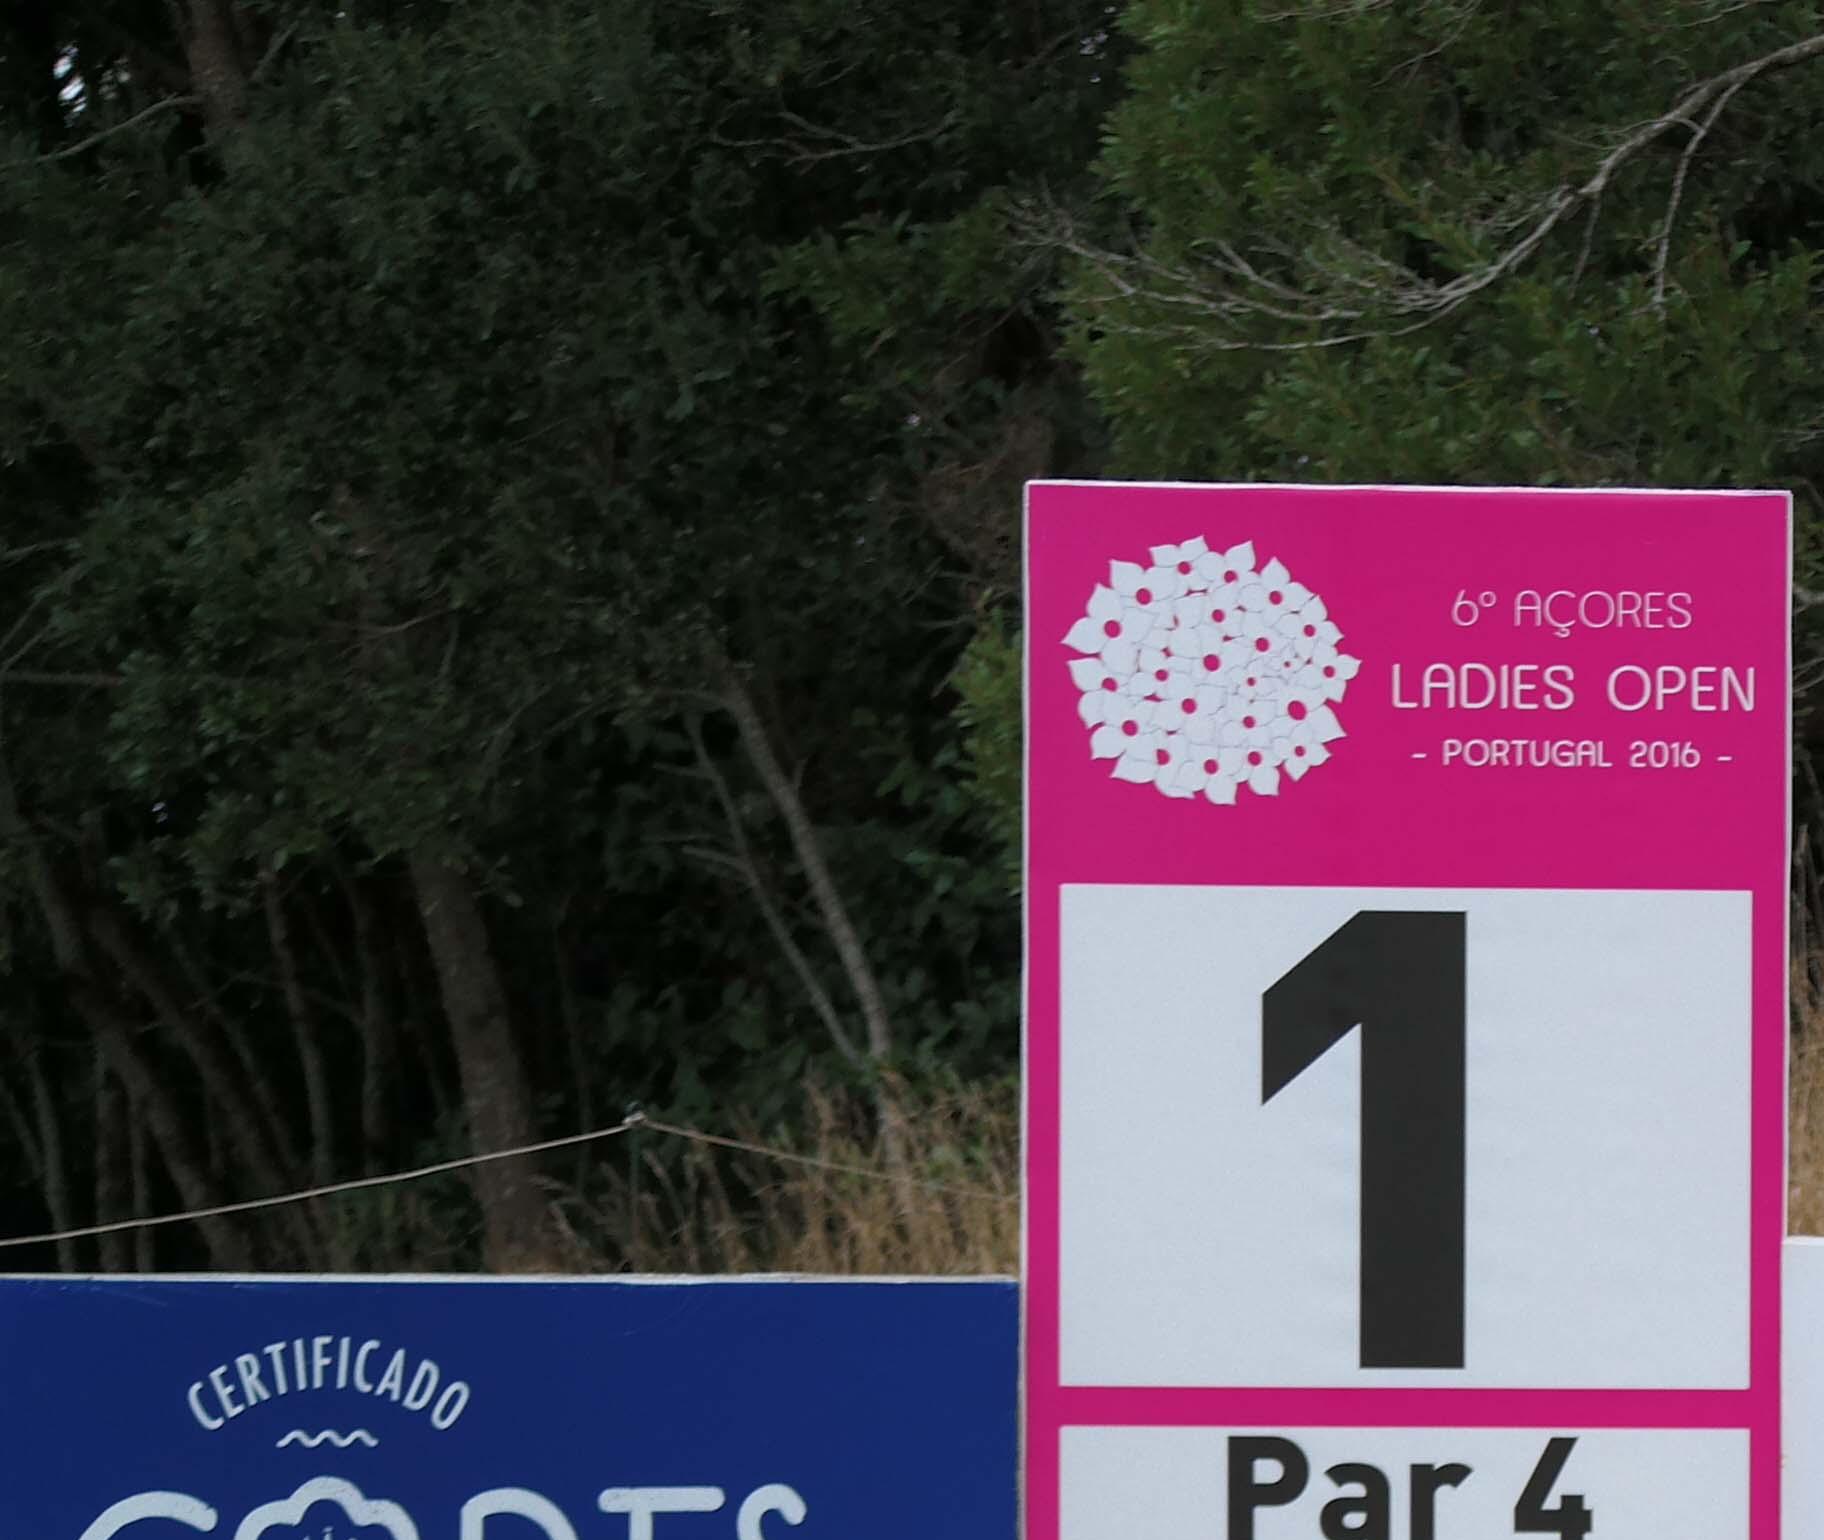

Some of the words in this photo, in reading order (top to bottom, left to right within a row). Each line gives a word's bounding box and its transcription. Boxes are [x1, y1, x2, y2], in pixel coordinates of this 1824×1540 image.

[1514, 590, 1692, 637] AÇORES
[1392, 662, 1575, 710] LADIES
[1607, 664, 1756, 712] OPEN
[1442, 738, 1613, 768] PORTUGAL
[1629, 740, 1701, 769] 2016
[1262, 910, 1467, 1369] 1
[188, 1335, 470, 1430] CERTIFICADO
